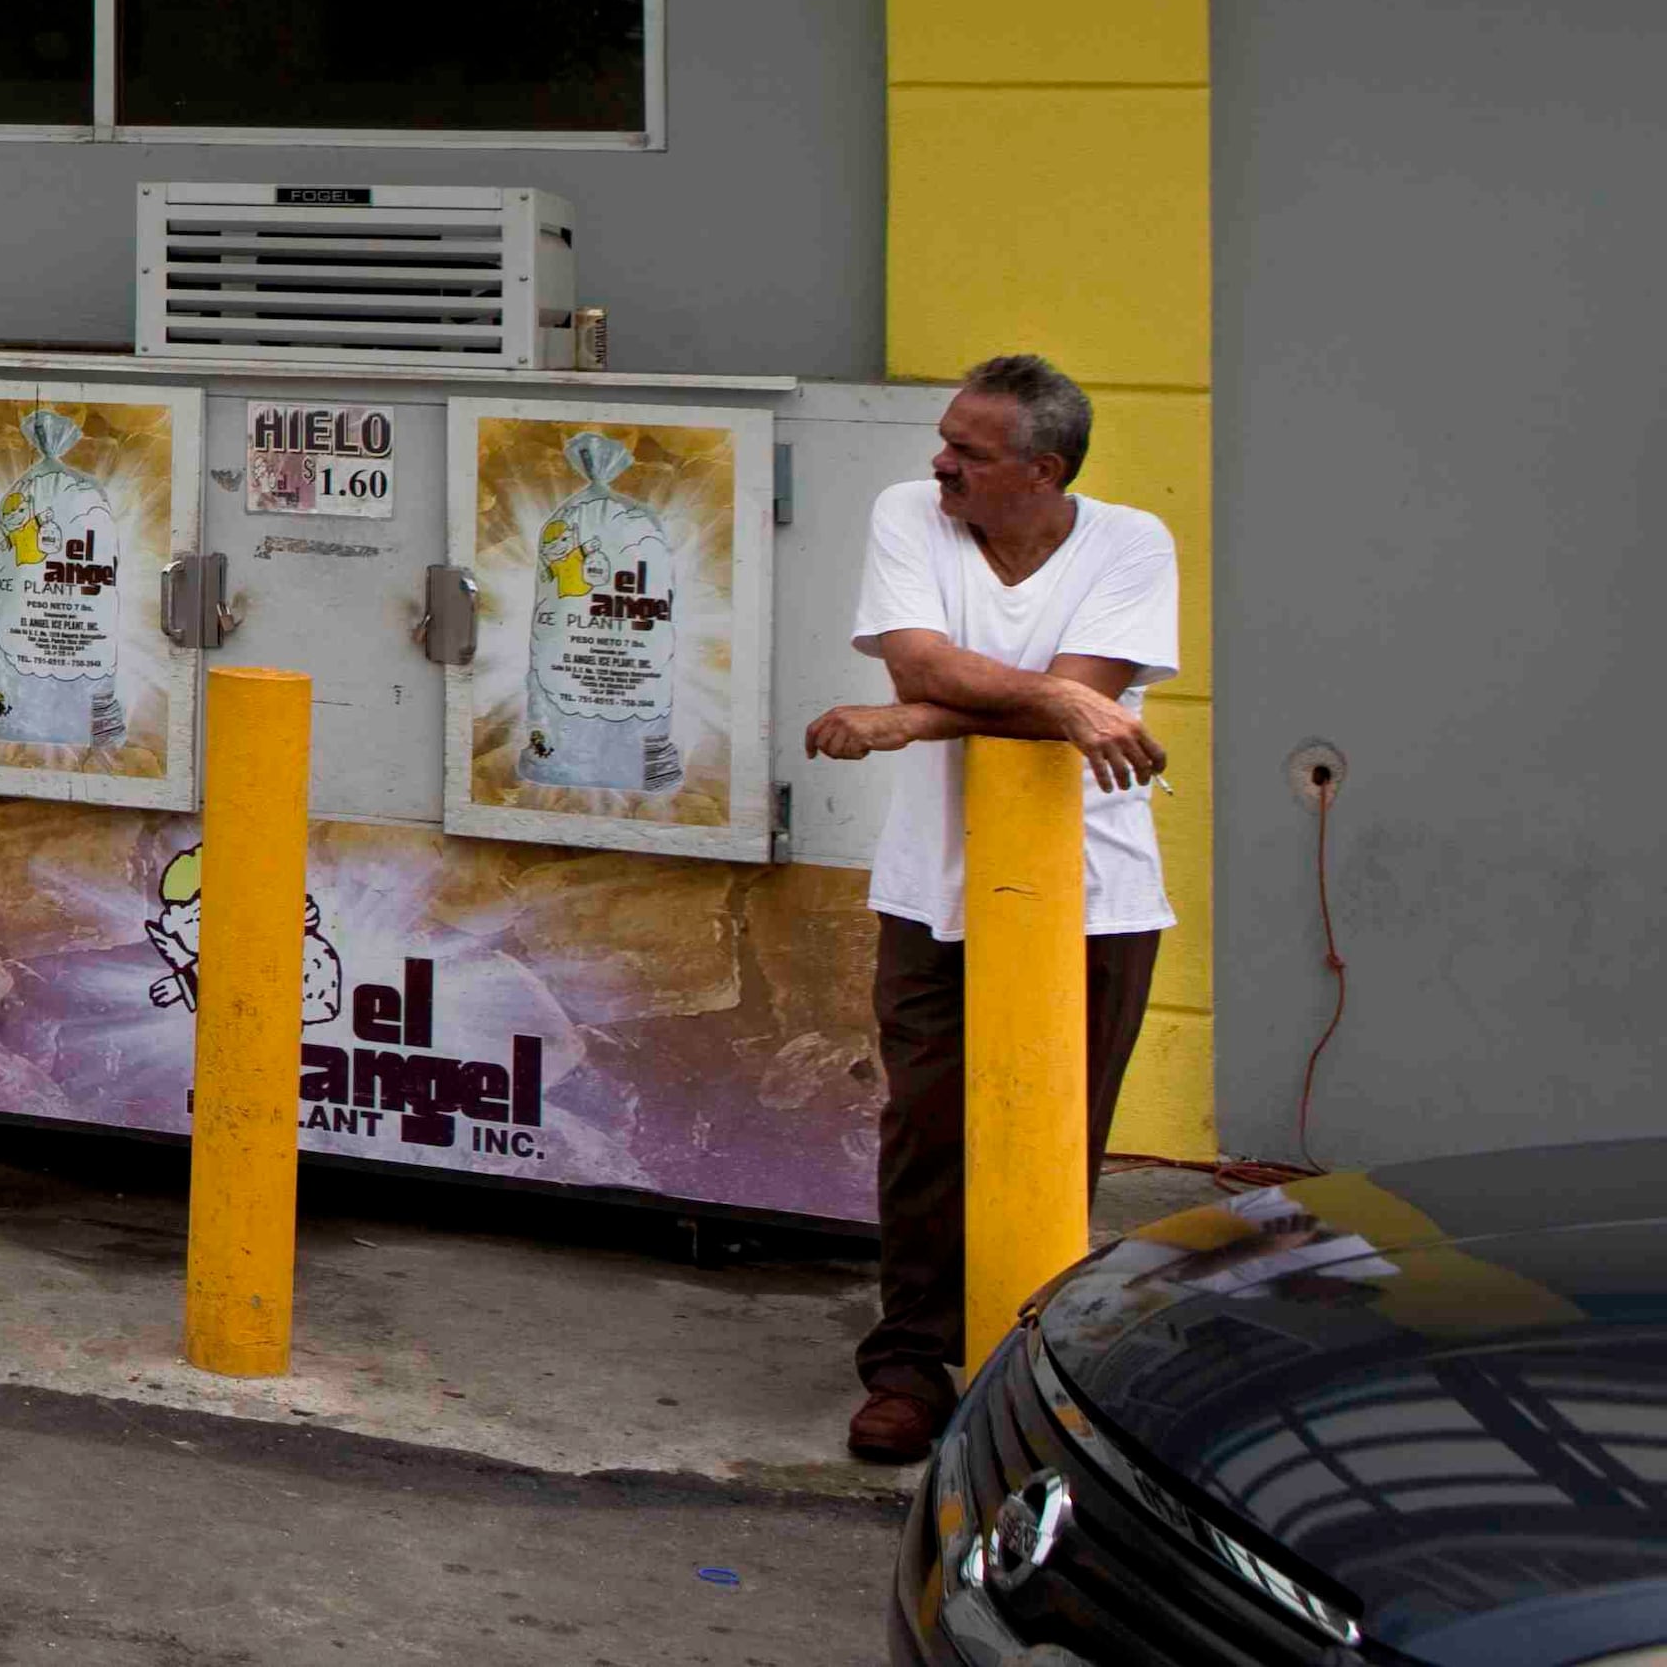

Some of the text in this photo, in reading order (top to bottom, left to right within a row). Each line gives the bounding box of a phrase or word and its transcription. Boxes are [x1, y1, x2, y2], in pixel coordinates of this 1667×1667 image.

[290, 190, 356, 203] FOGEL
[254, 407, 392, 459] HIELO
[65, 529, 95, 561] el
[24, 580, 77, 596] PLANT
[614, 560, 647, 595] el
[567, 613, 627, 632] PLANT
[353, 956, 435, 1049] el
[298, 1034, 543, 1148] angel
[471, 1125, 546, 1160] INC.
